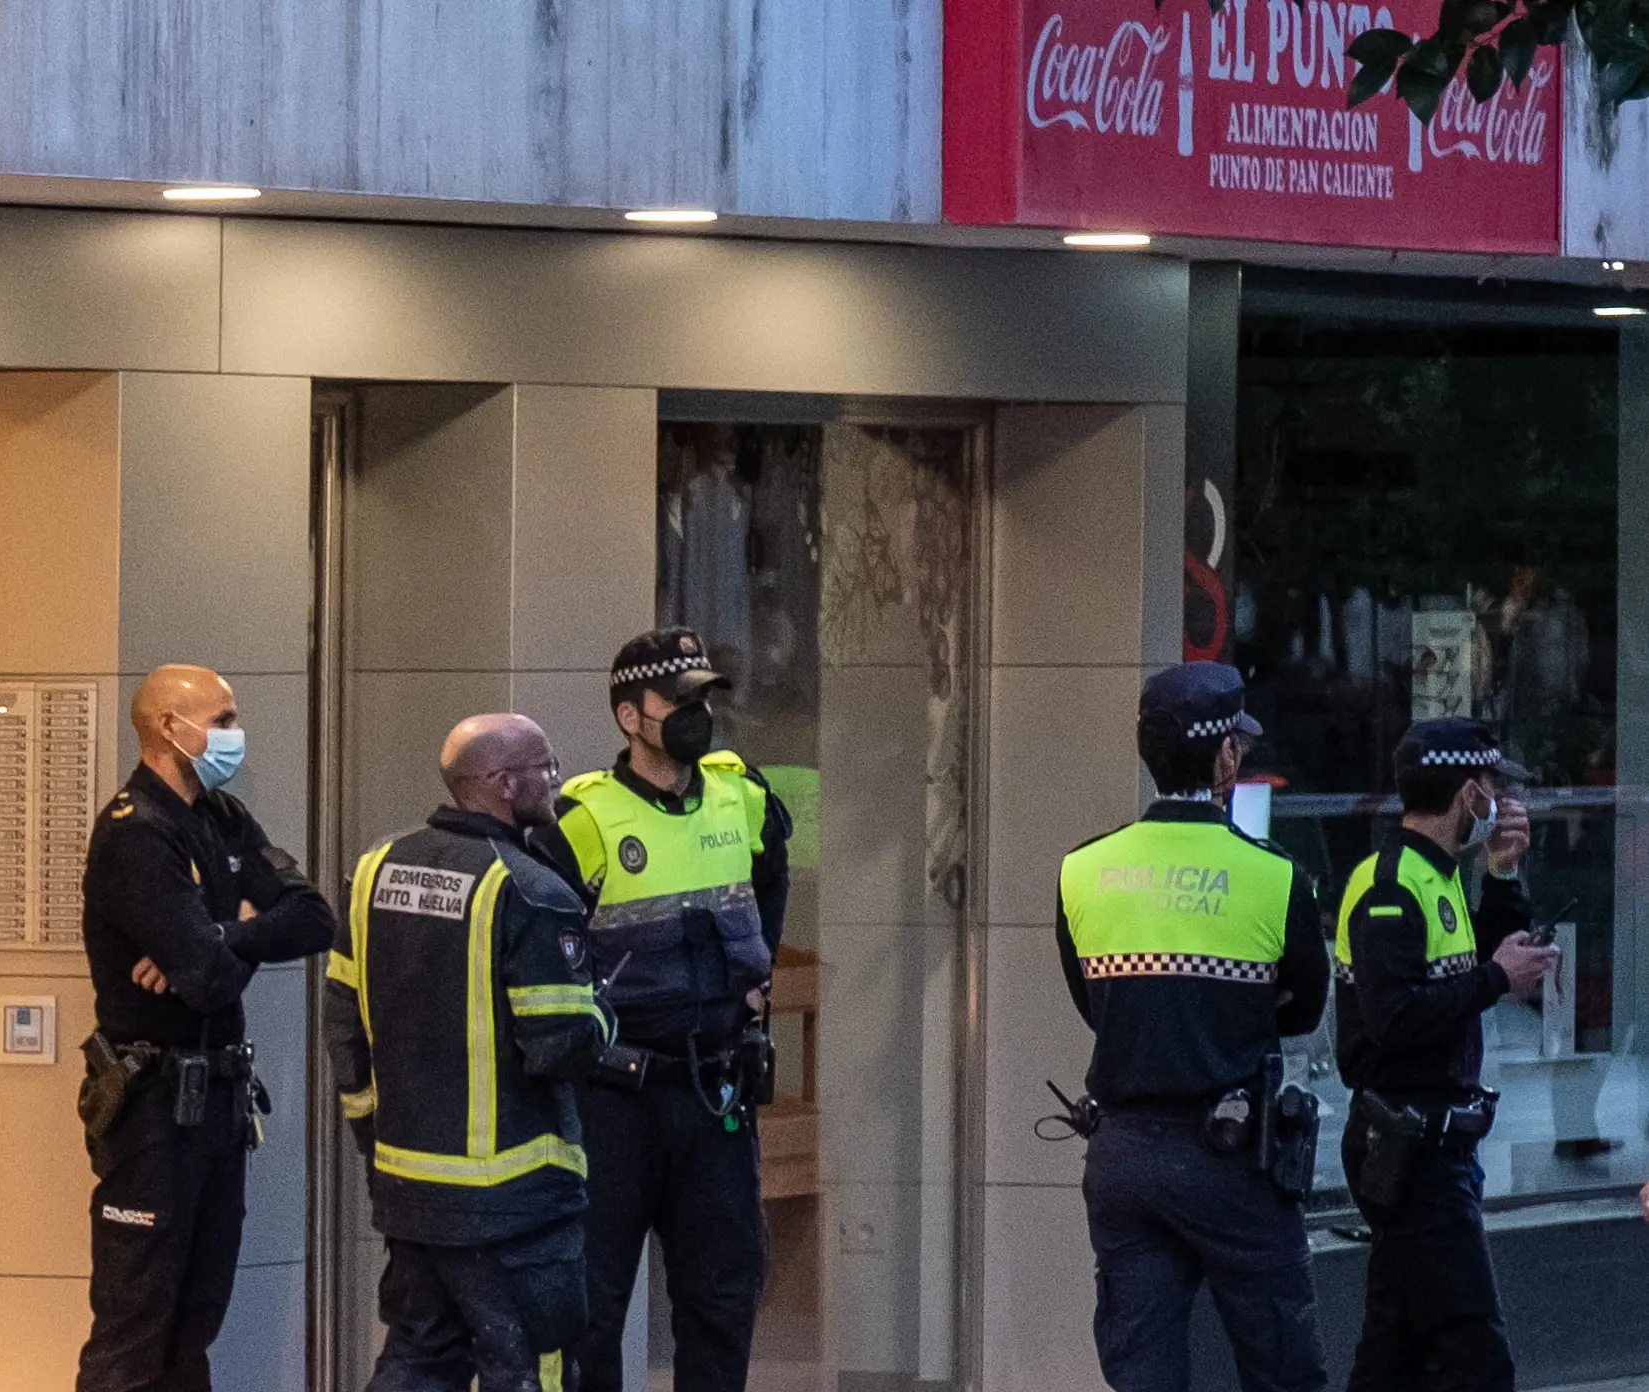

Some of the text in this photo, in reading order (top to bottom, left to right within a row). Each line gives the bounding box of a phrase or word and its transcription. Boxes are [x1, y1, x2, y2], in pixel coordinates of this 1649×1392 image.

[1208, 0, 1255, 83] EL
[1026, 14, 1171, 136] Coca-Cola
[1227, 102, 1379, 153] ALIMENTACION
[1209, 153, 1394, 199] PUNTO DE PAN CALIENTE
[699, 829, 742, 851] POLICIA
[376, 887, 463, 915] AYTO. HUELVA
[389, 868, 463, 893] BOMBEROS
